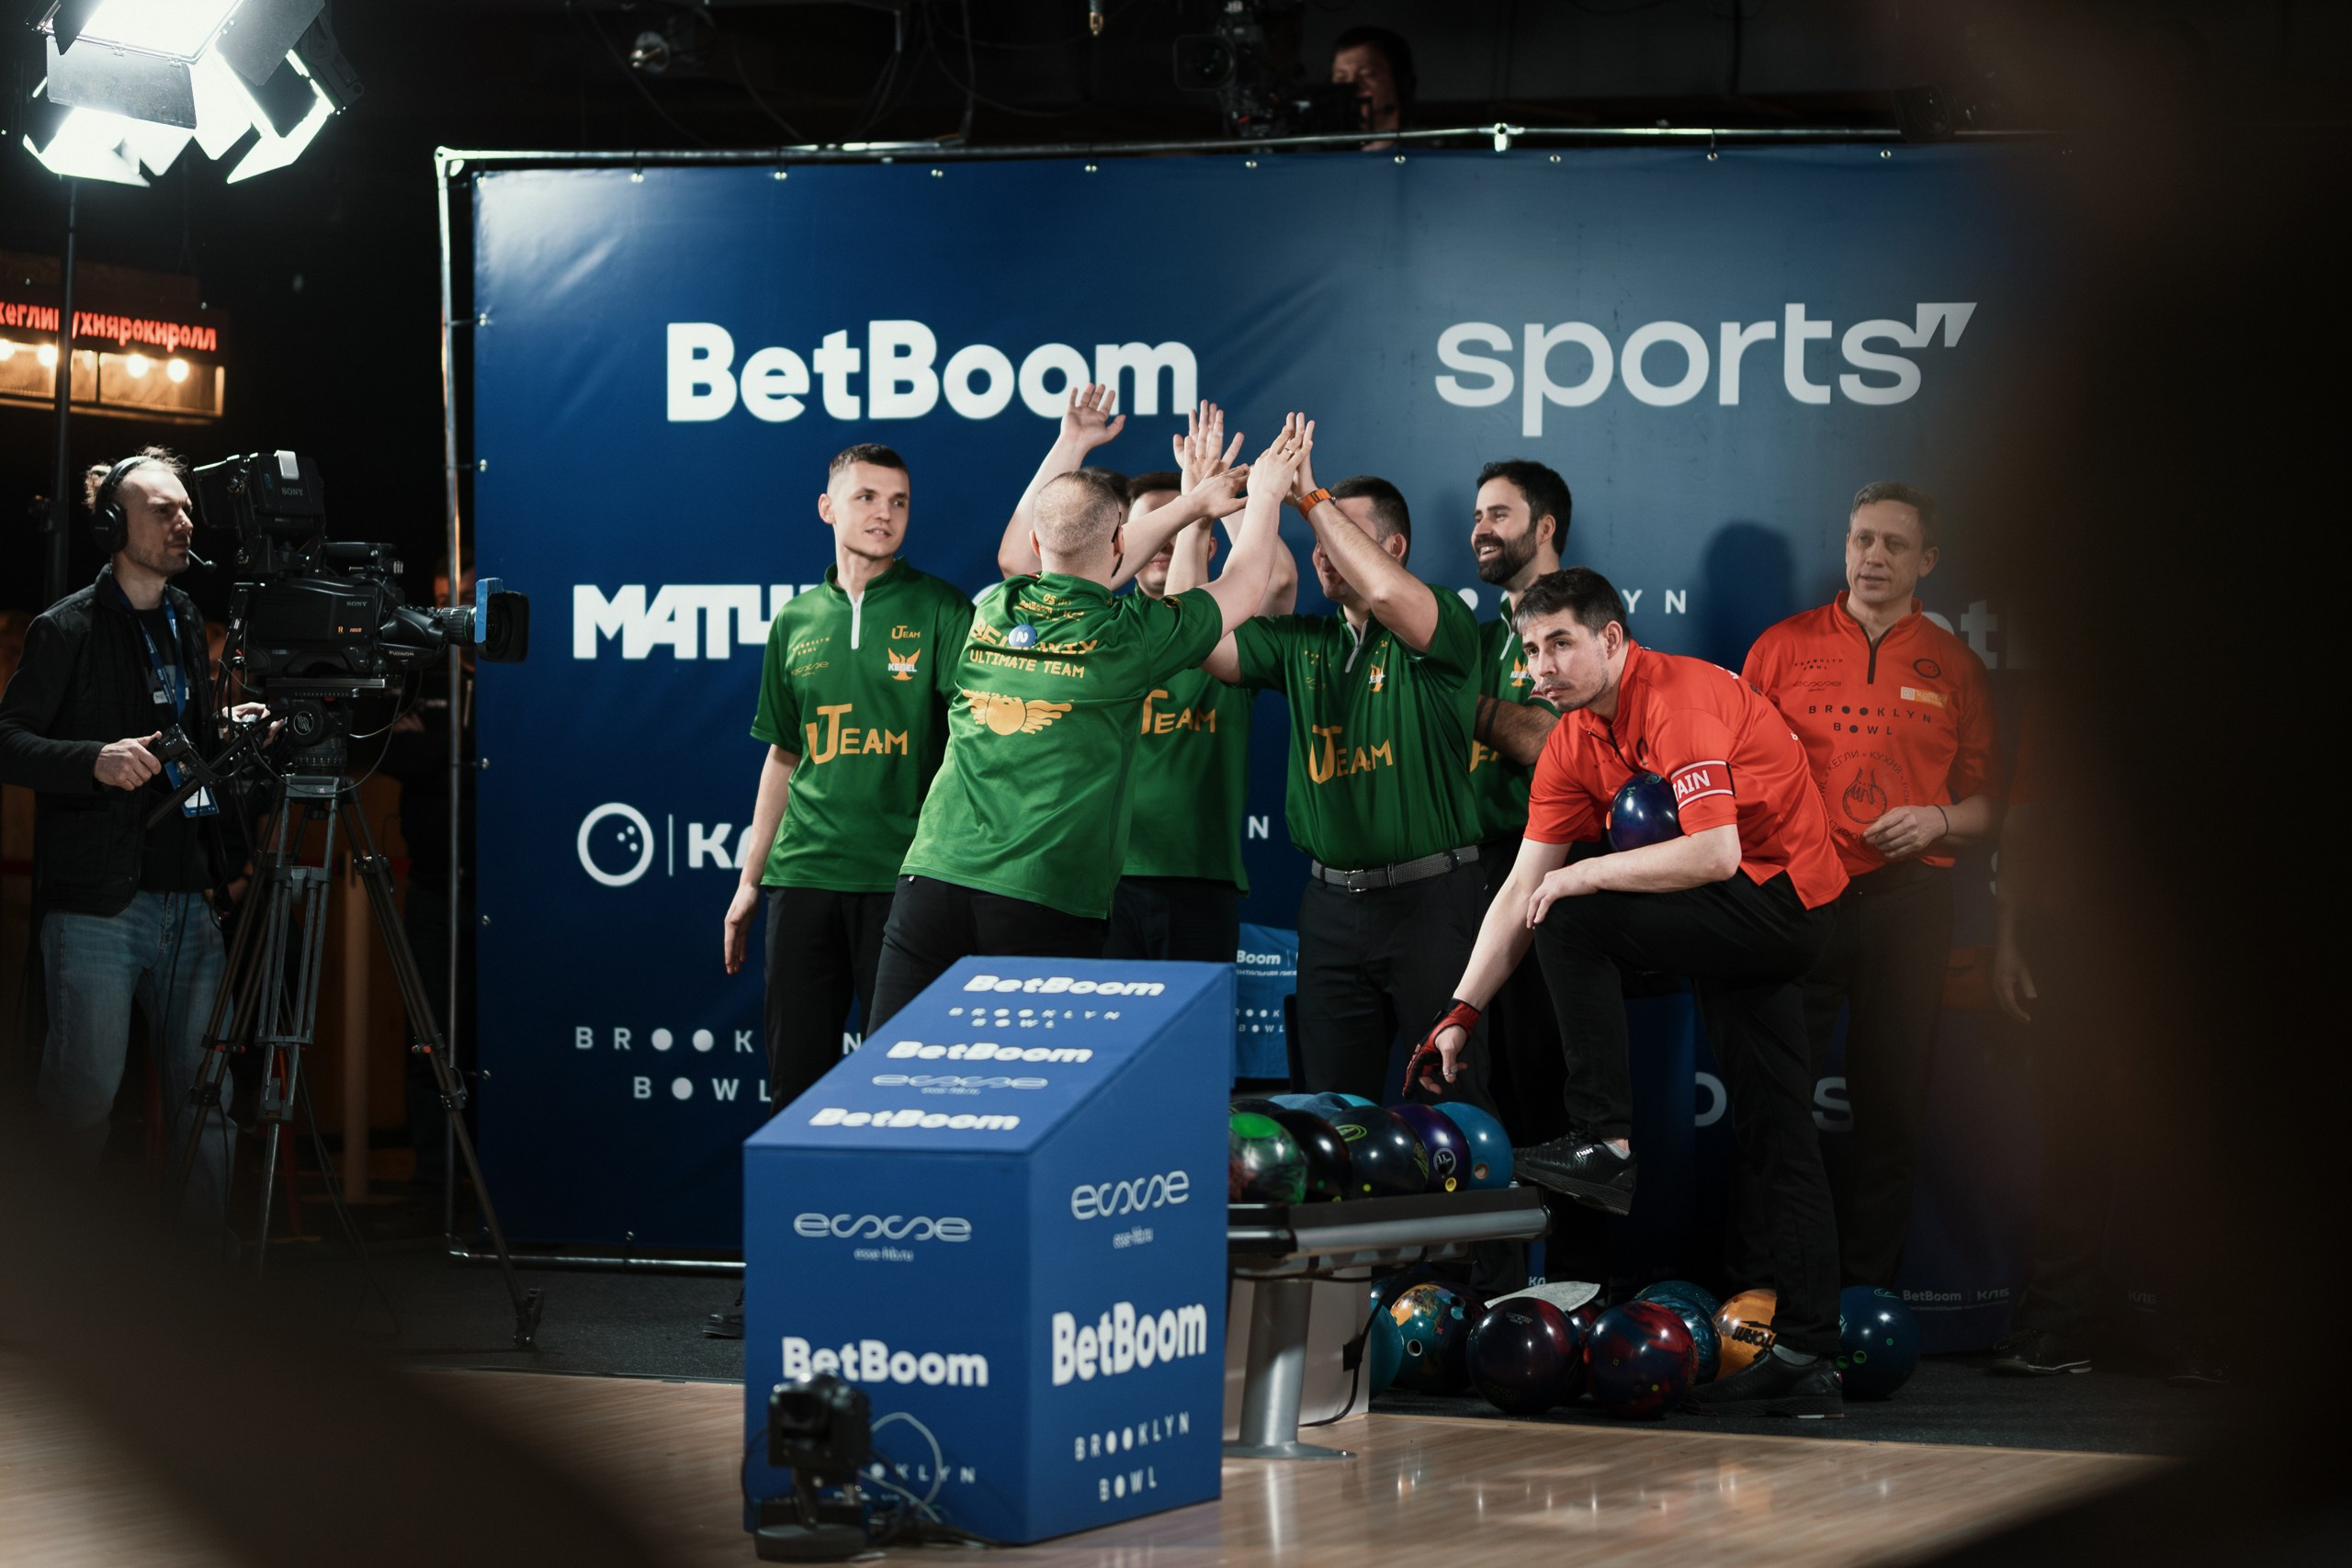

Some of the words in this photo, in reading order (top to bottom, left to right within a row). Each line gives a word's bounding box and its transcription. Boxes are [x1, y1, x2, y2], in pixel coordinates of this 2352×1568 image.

[667, 320, 1197, 423] BetBoom
[281, 487, 303, 496] SONY
[888, 662, 918, 672] KEGEL
[969, 649, 1037, 671] ULTIMATE
[1044, 660, 1085, 678] TEAM
[1809, 705, 1931, 723] BROOKLYN
[1834, 723, 1893, 735] BOWL
[1237, 950, 1282, 964] Boom
[964, 975, 1165, 996] BetBoom
[1238, 1024, 1284, 1032] BOWL
[887, 1041, 1093, 1063] BetBoom
[633, 1076, 772, 1102] BOWL
[809, 1109, 1020, 1130] BetBoom
[1903, 1290, 1962, 1302] BetBoom
[1052, 1301, 1207, 1386] BetBoom
[782, 1337, 989, 1387] BetBoom
[1074, 1411, 1189, 1461] BROOKLYN
[1099, 1466, 1157, 1502] BOWL
